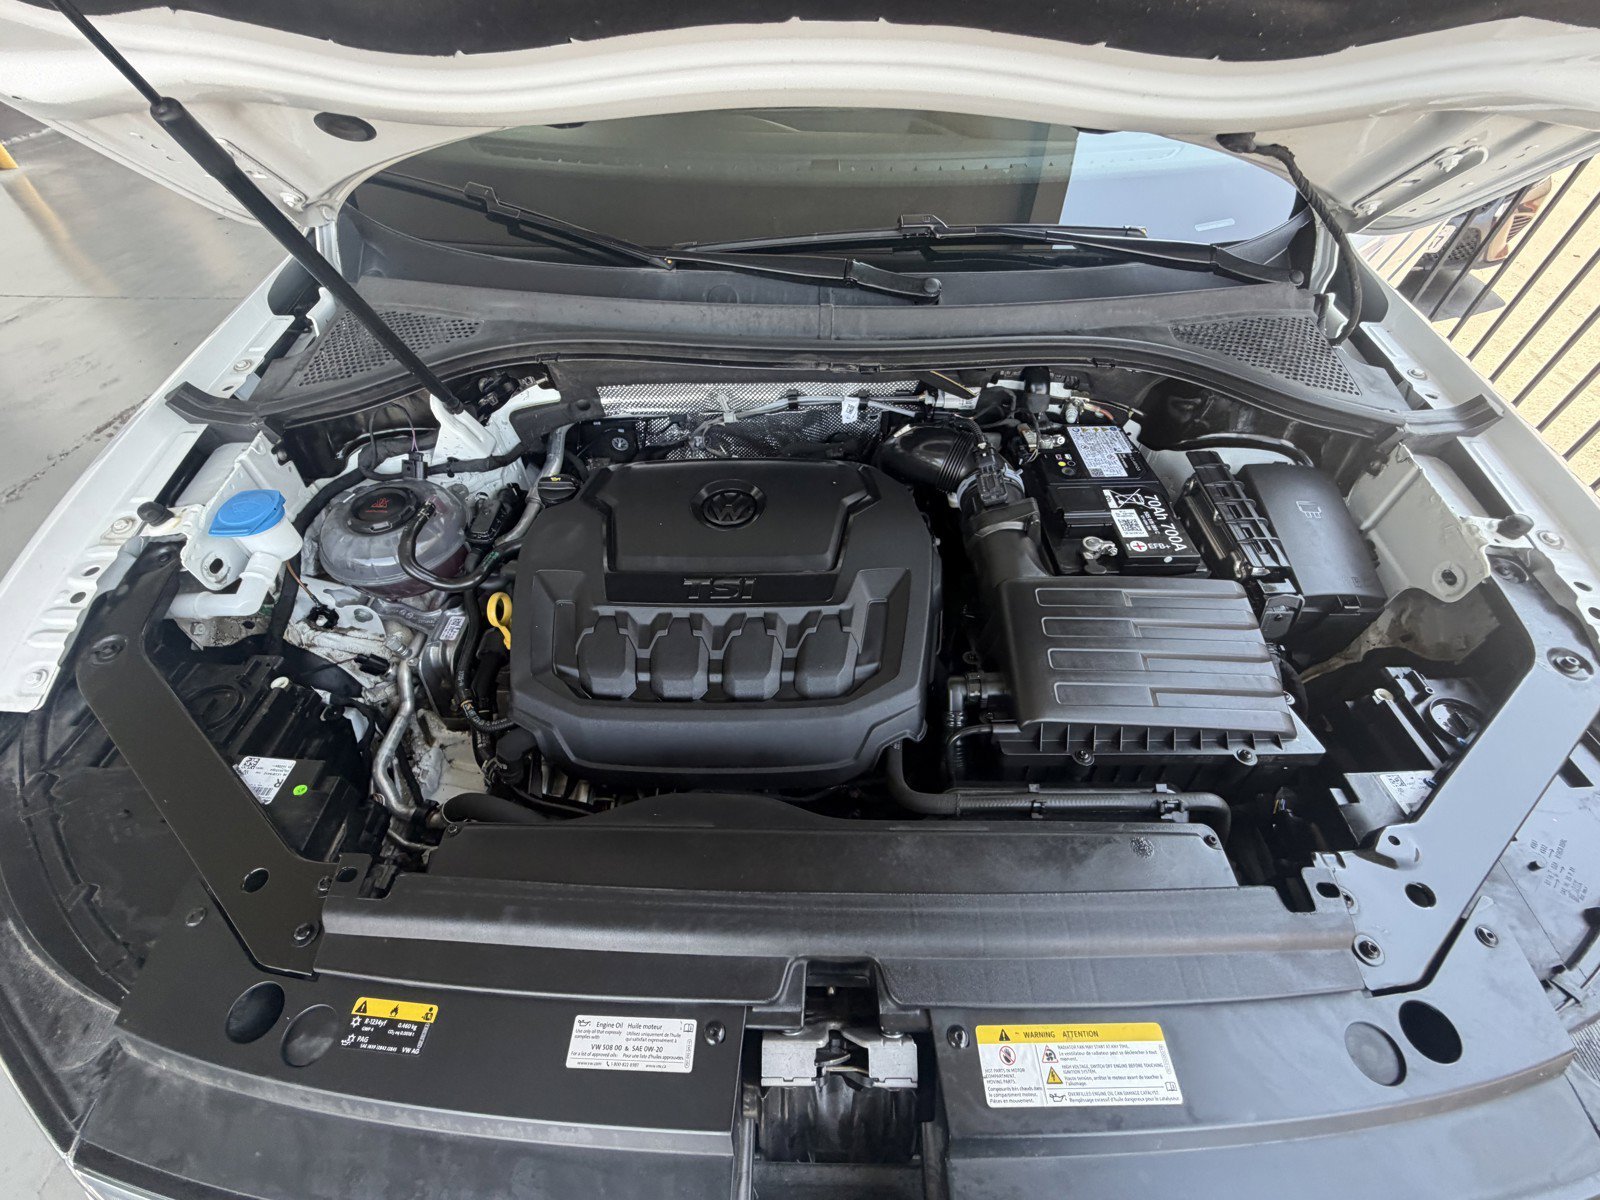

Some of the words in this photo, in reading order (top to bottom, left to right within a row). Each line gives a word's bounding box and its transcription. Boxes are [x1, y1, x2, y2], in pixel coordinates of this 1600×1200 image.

[1144, 494, 1168, 520] 70Ah
[1160, 522, 1188, 552] 700A
[683, 578, 756, 599] TSI
[364, 1018, 388, 1028] R-1234yf
